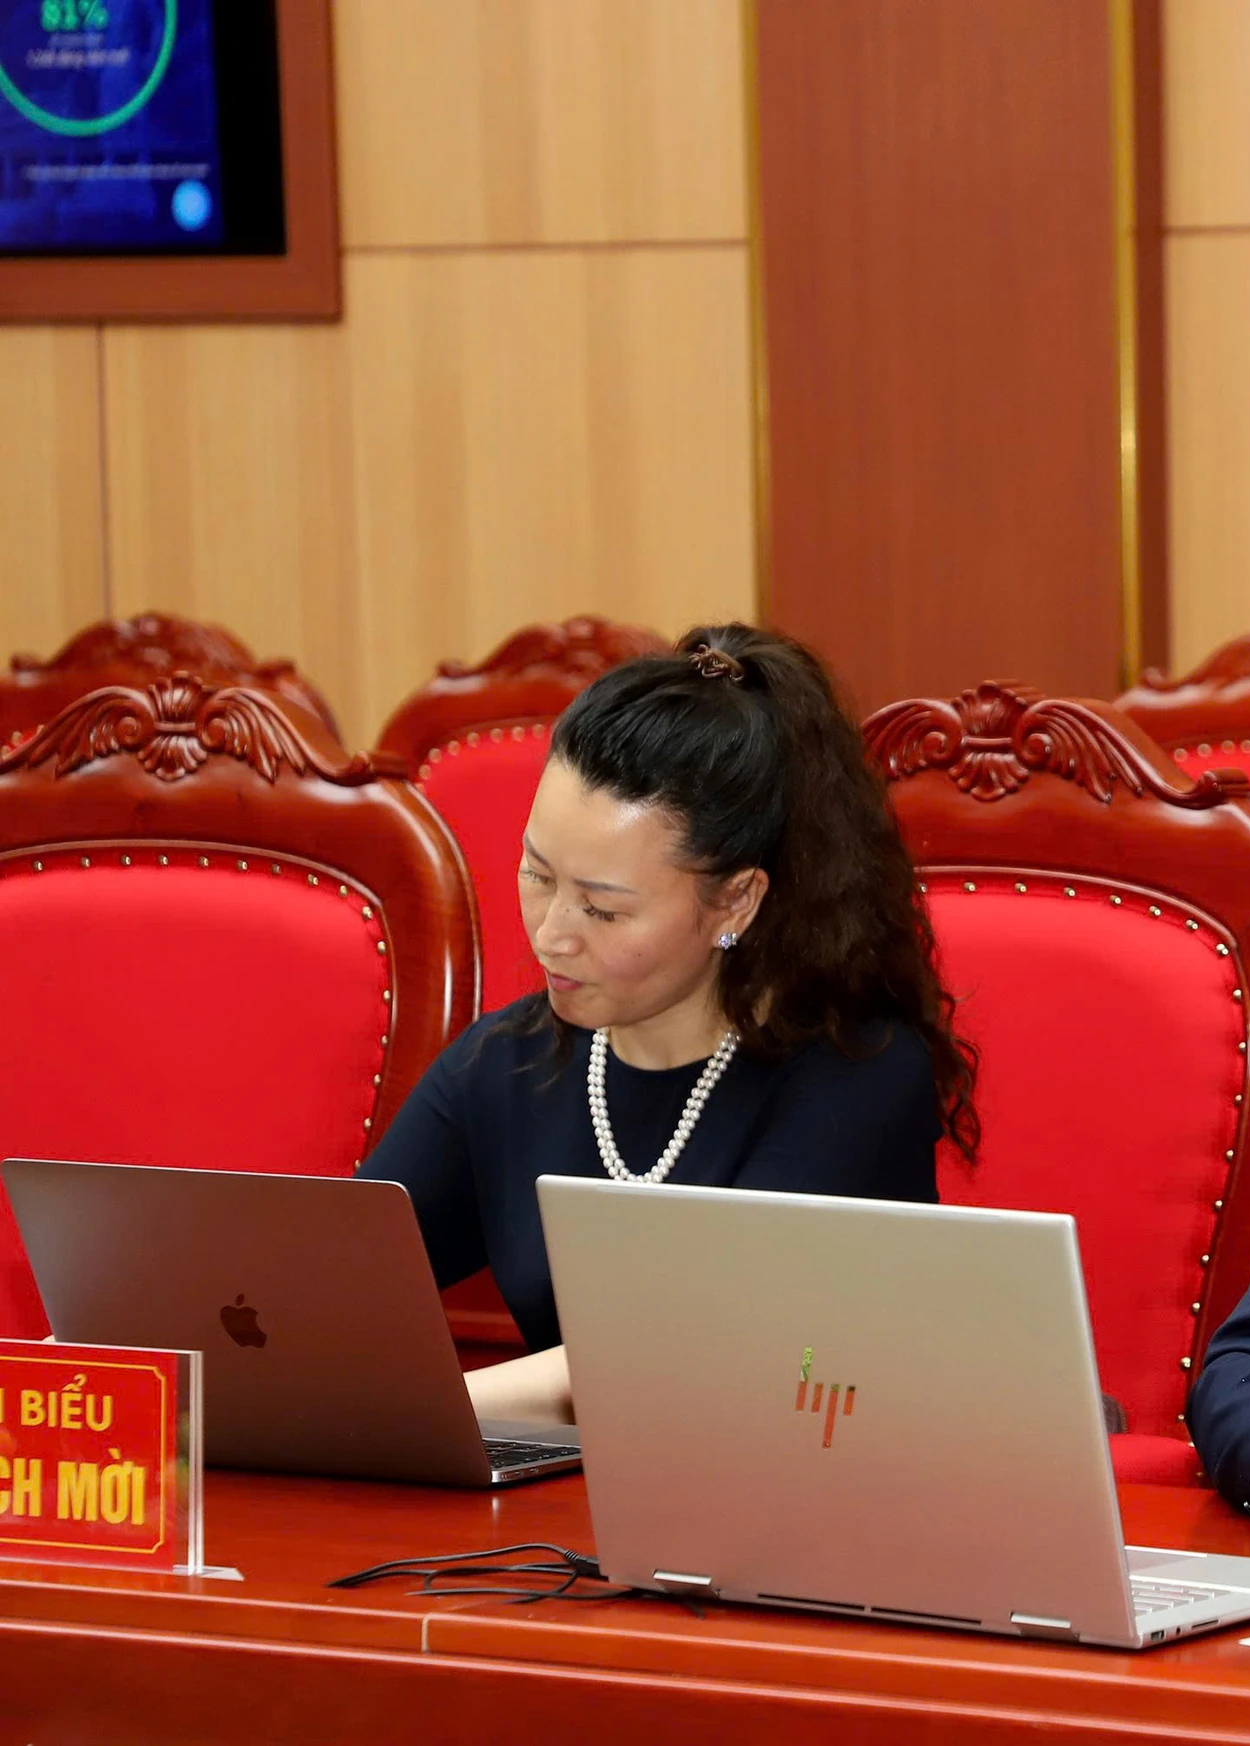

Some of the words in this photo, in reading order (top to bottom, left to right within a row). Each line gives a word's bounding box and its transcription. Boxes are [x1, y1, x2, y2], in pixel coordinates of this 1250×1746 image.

[41, 0, 109, 31] 81%
[20, 1373, 113, 1431] BIỂU
[57, 1447, 146, 1526] MỜI
